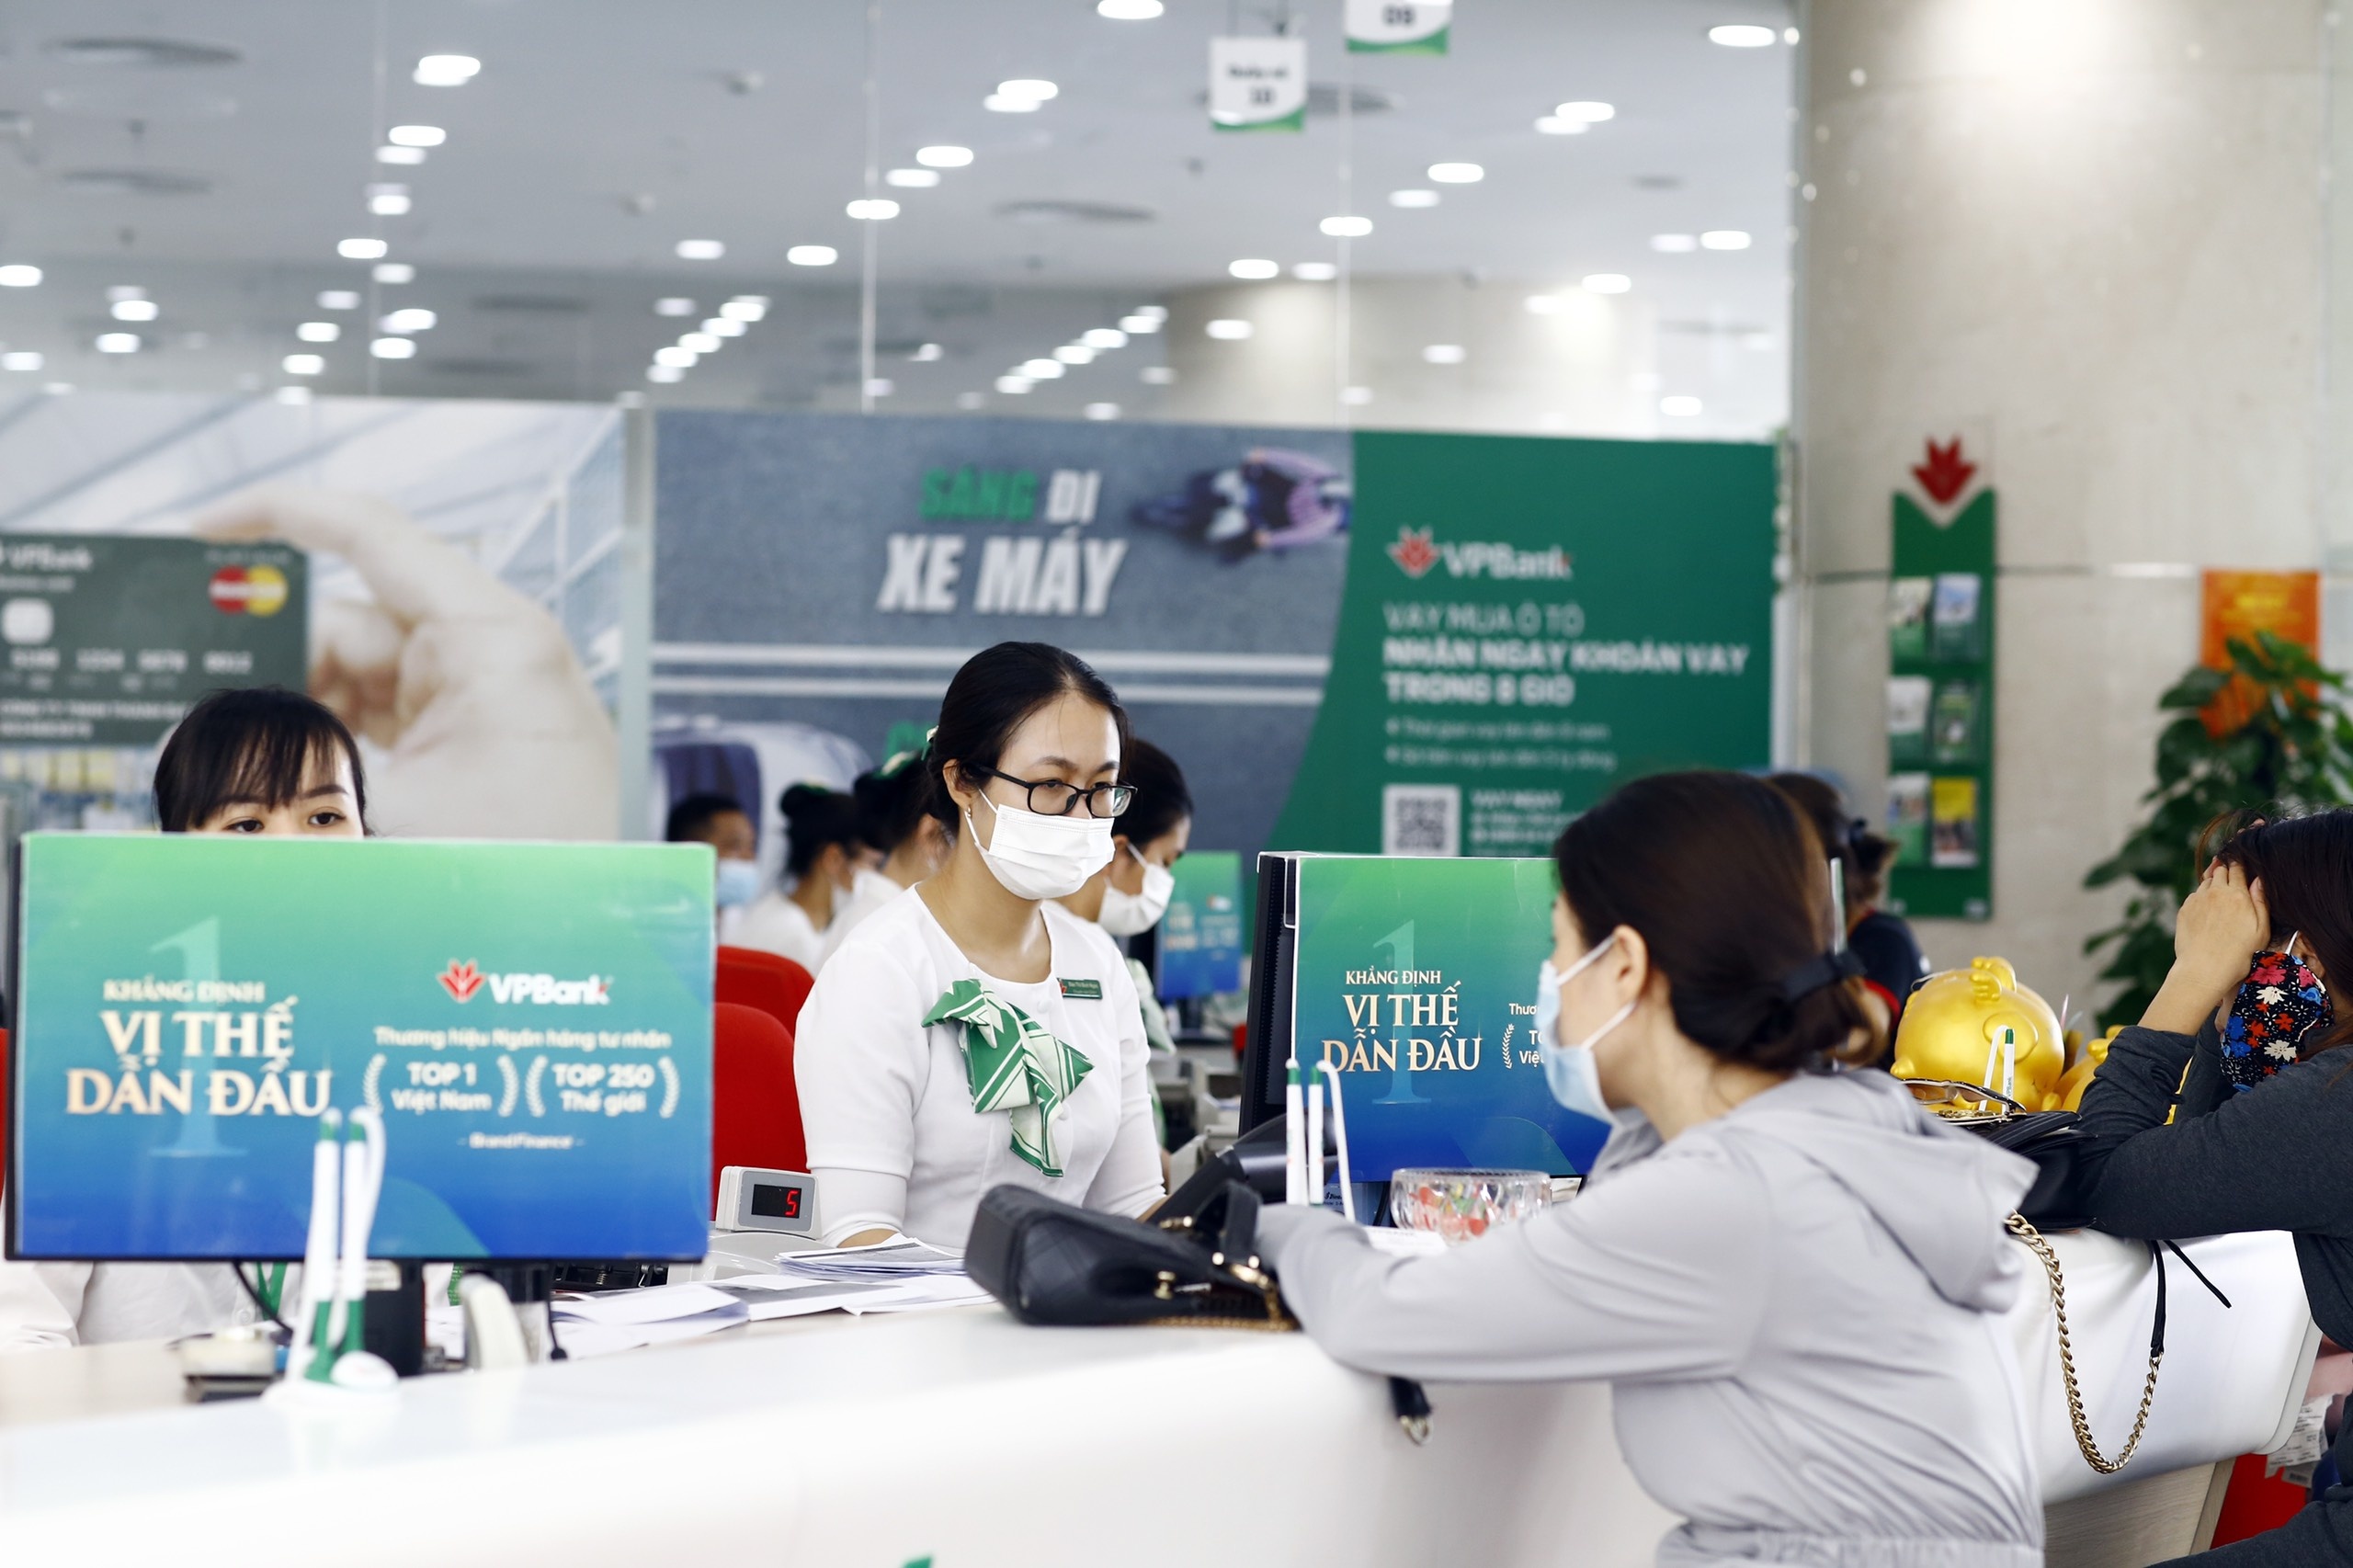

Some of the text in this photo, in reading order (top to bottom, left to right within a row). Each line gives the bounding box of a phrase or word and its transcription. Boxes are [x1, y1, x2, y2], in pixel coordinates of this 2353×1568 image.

[875, 525, 1129, 617] XE MÁY
[1442, 542, 1573, 579] VPBank
[1382, 601, 1444, 633] VAY
[1445, 601, 1514, 634] MUA
[1480, 638, 1567, 672] NGAY
[1685, 643, 1749, 676] VAY
[1382, 670, 1493, 706] TRONG
[488, 972, 614, 1005] VPBank
[1346, 965, 1441, 988] KHẲNG ĐỊNH
[1342, 980, 1461, 1035] VỊ THẾ
[1508, 1003, 1538, 1016] Thươ
[100, 994, 299, 1067] VỊ THẾ
[1322, 1026, 1483, 1073] DẪN ĐẦU
[65, 1054, 333, 1116] DẪN ĐẦU
[407, 1061, 476, 1086] TOP 1
[553, 1063, 655, 1087] TOP 250
[392, 1088, 492, 1115] Việt Nam
[560, 1087, 602, 1111] Thế
[785, 1189, 799, 1217] 5
